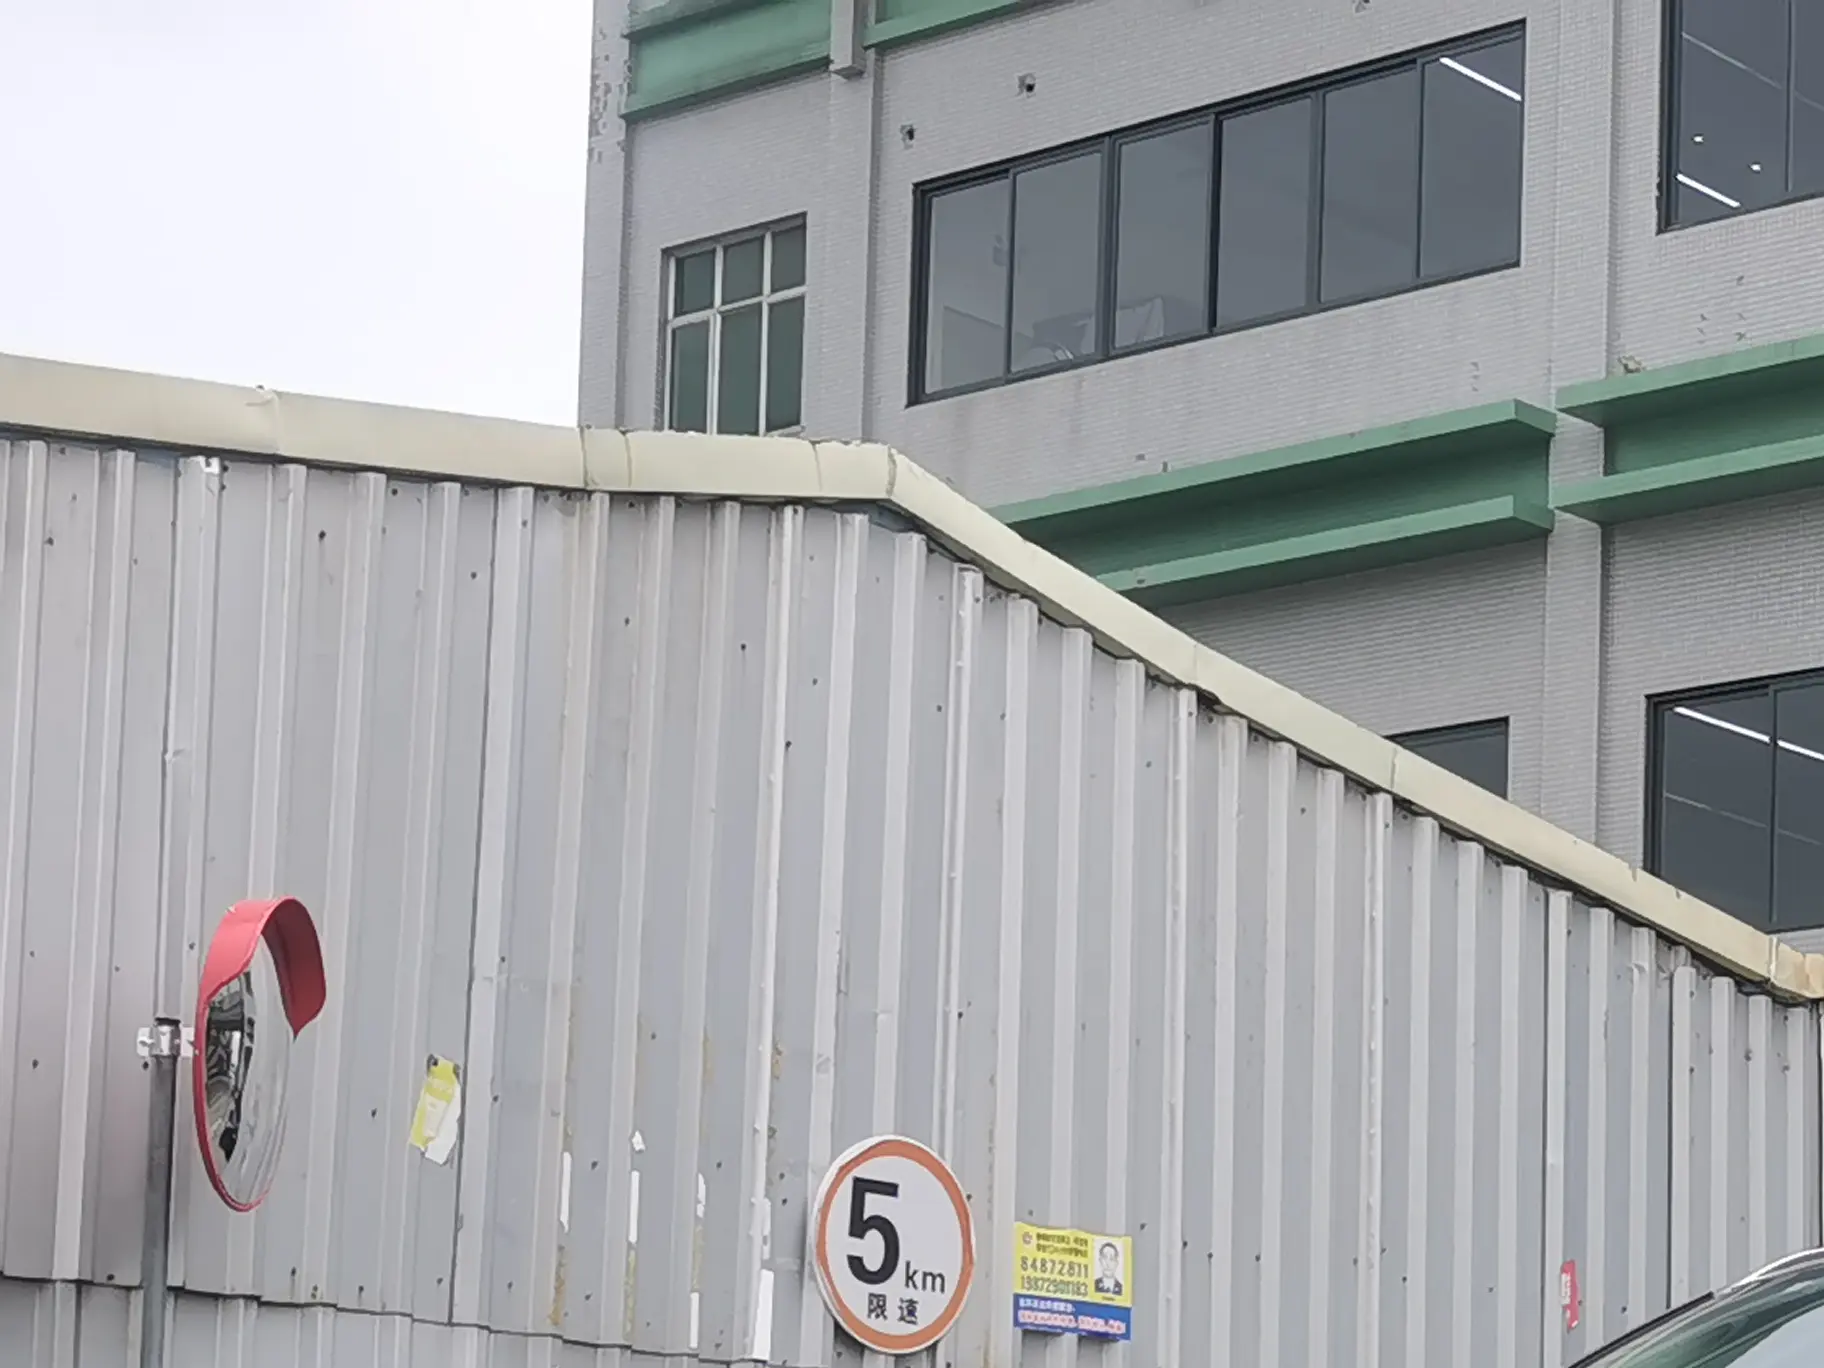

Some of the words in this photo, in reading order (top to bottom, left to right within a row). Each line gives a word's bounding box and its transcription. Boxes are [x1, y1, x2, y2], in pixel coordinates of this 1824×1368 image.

[846, 1176, 900, 1285] 5
[904, 1260, 946, 1294] km
[867, 1292, 919, 1325] 限速
